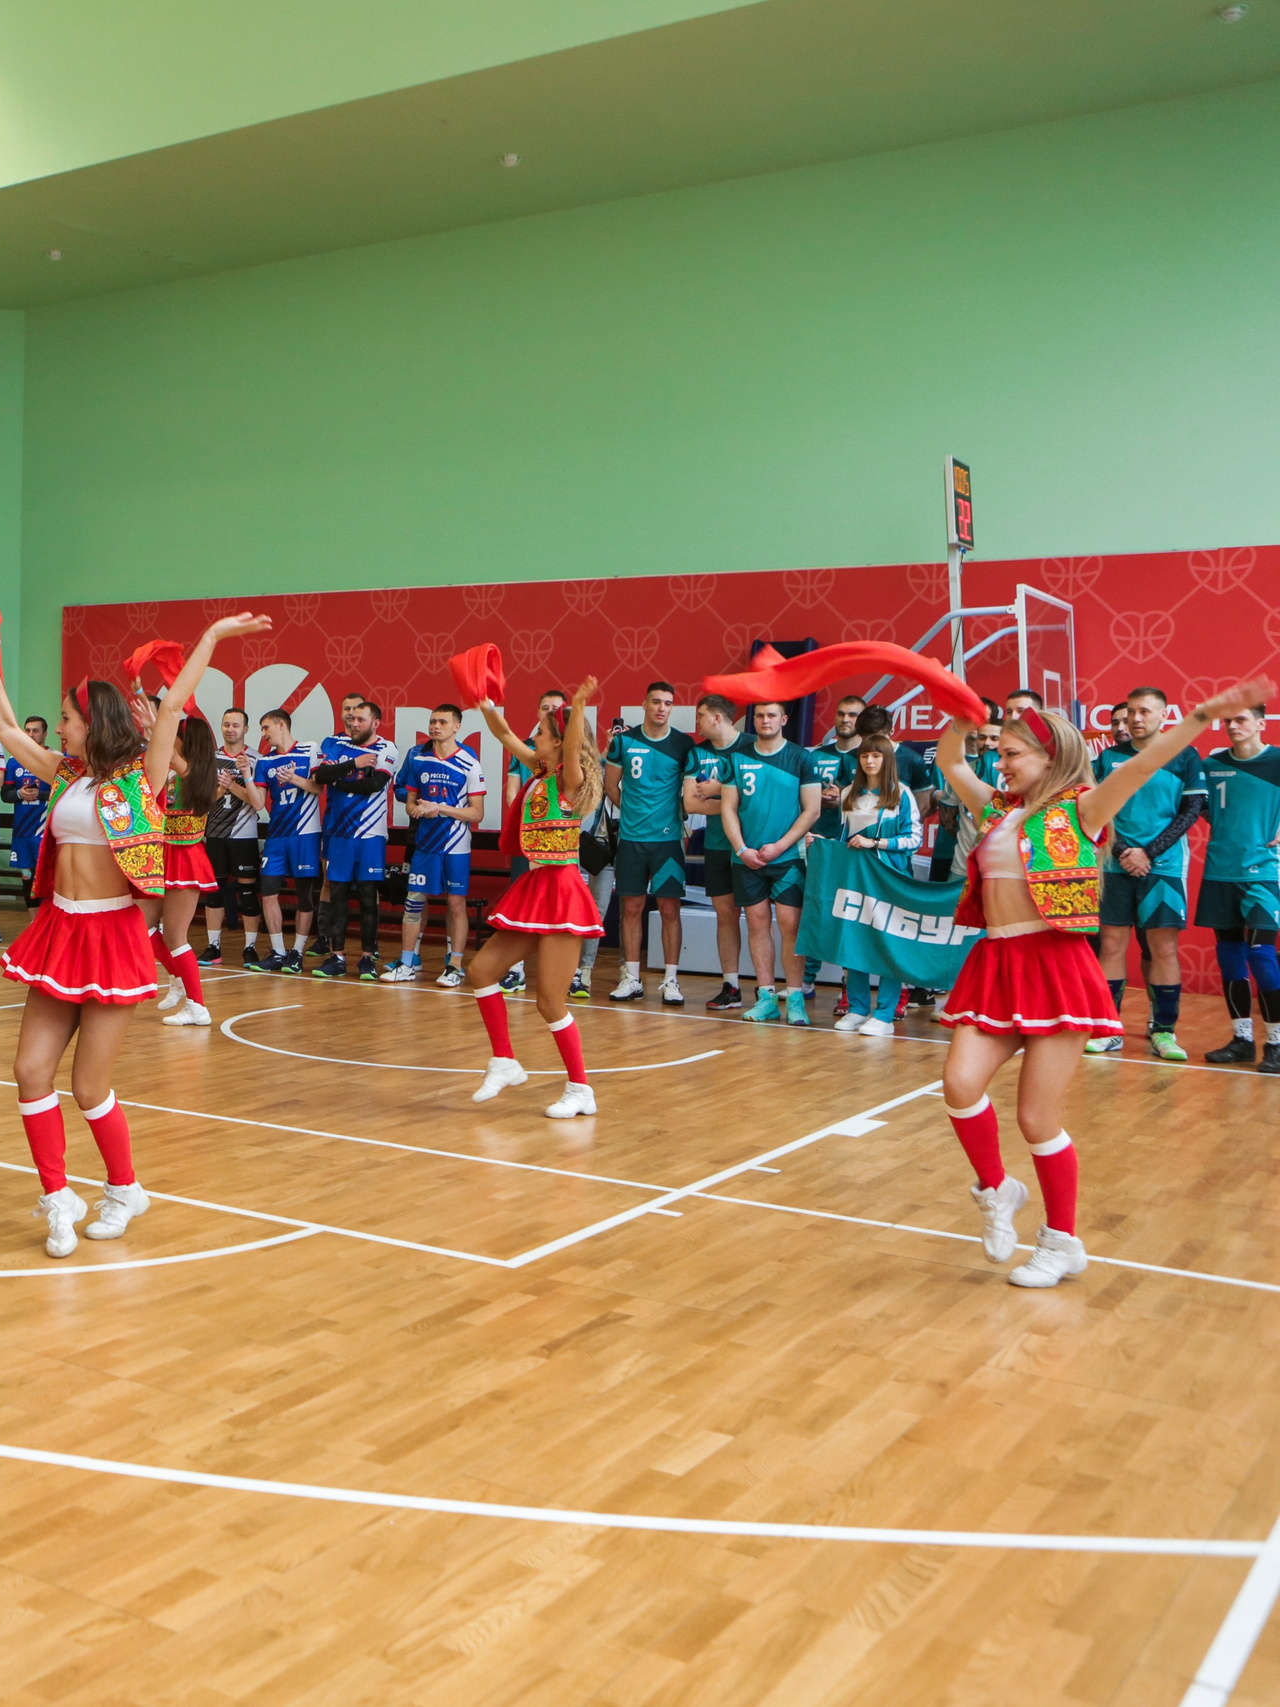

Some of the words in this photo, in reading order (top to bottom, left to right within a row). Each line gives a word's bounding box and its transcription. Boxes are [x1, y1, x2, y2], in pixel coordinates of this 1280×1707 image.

[631, 756, 643, 779] 8
[742, 772, 756, 796] 3
[1215, 781, 1227, 809] 1
[222, 794, 232, 809] 1
[279, 787, 298, 806] 17
[408, 873, 426, 886] 20
[832, 888, 981, 945] СИБУР
